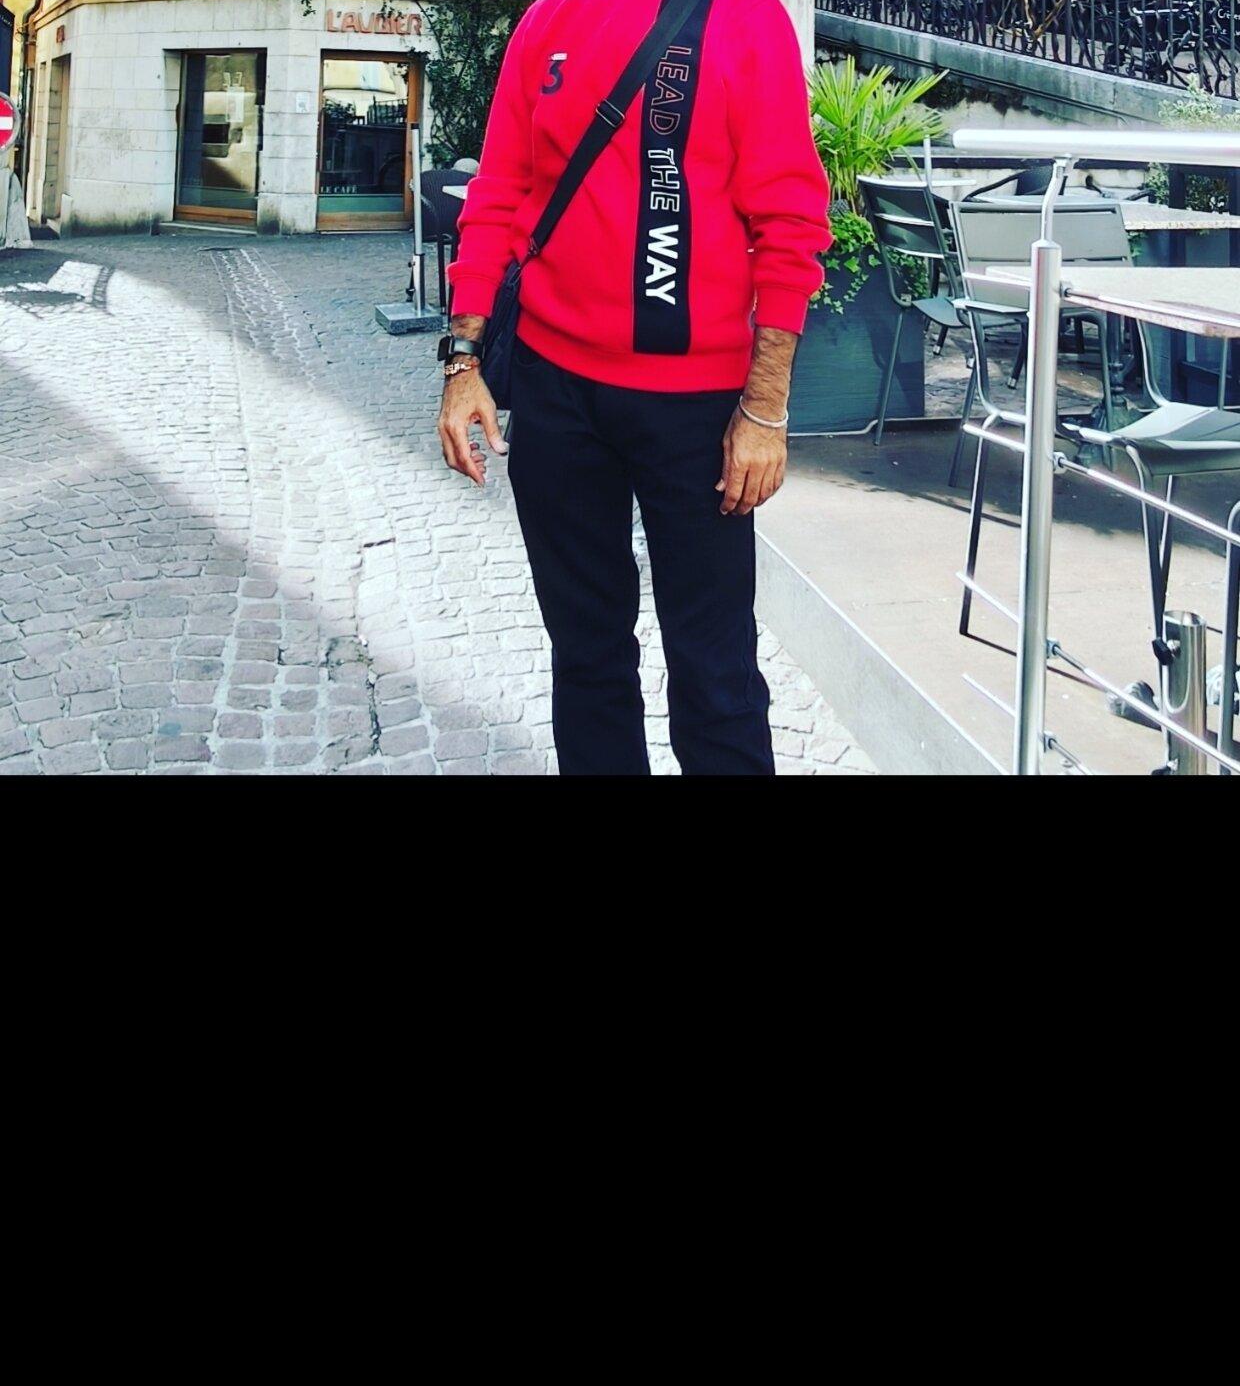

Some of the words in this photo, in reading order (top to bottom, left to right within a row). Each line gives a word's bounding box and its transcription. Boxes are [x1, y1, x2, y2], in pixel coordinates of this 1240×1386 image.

[649, 45, 692, 135] LEAD
[647, 147, 680, 213] THE
[645, 224, 680, 306] WAY
